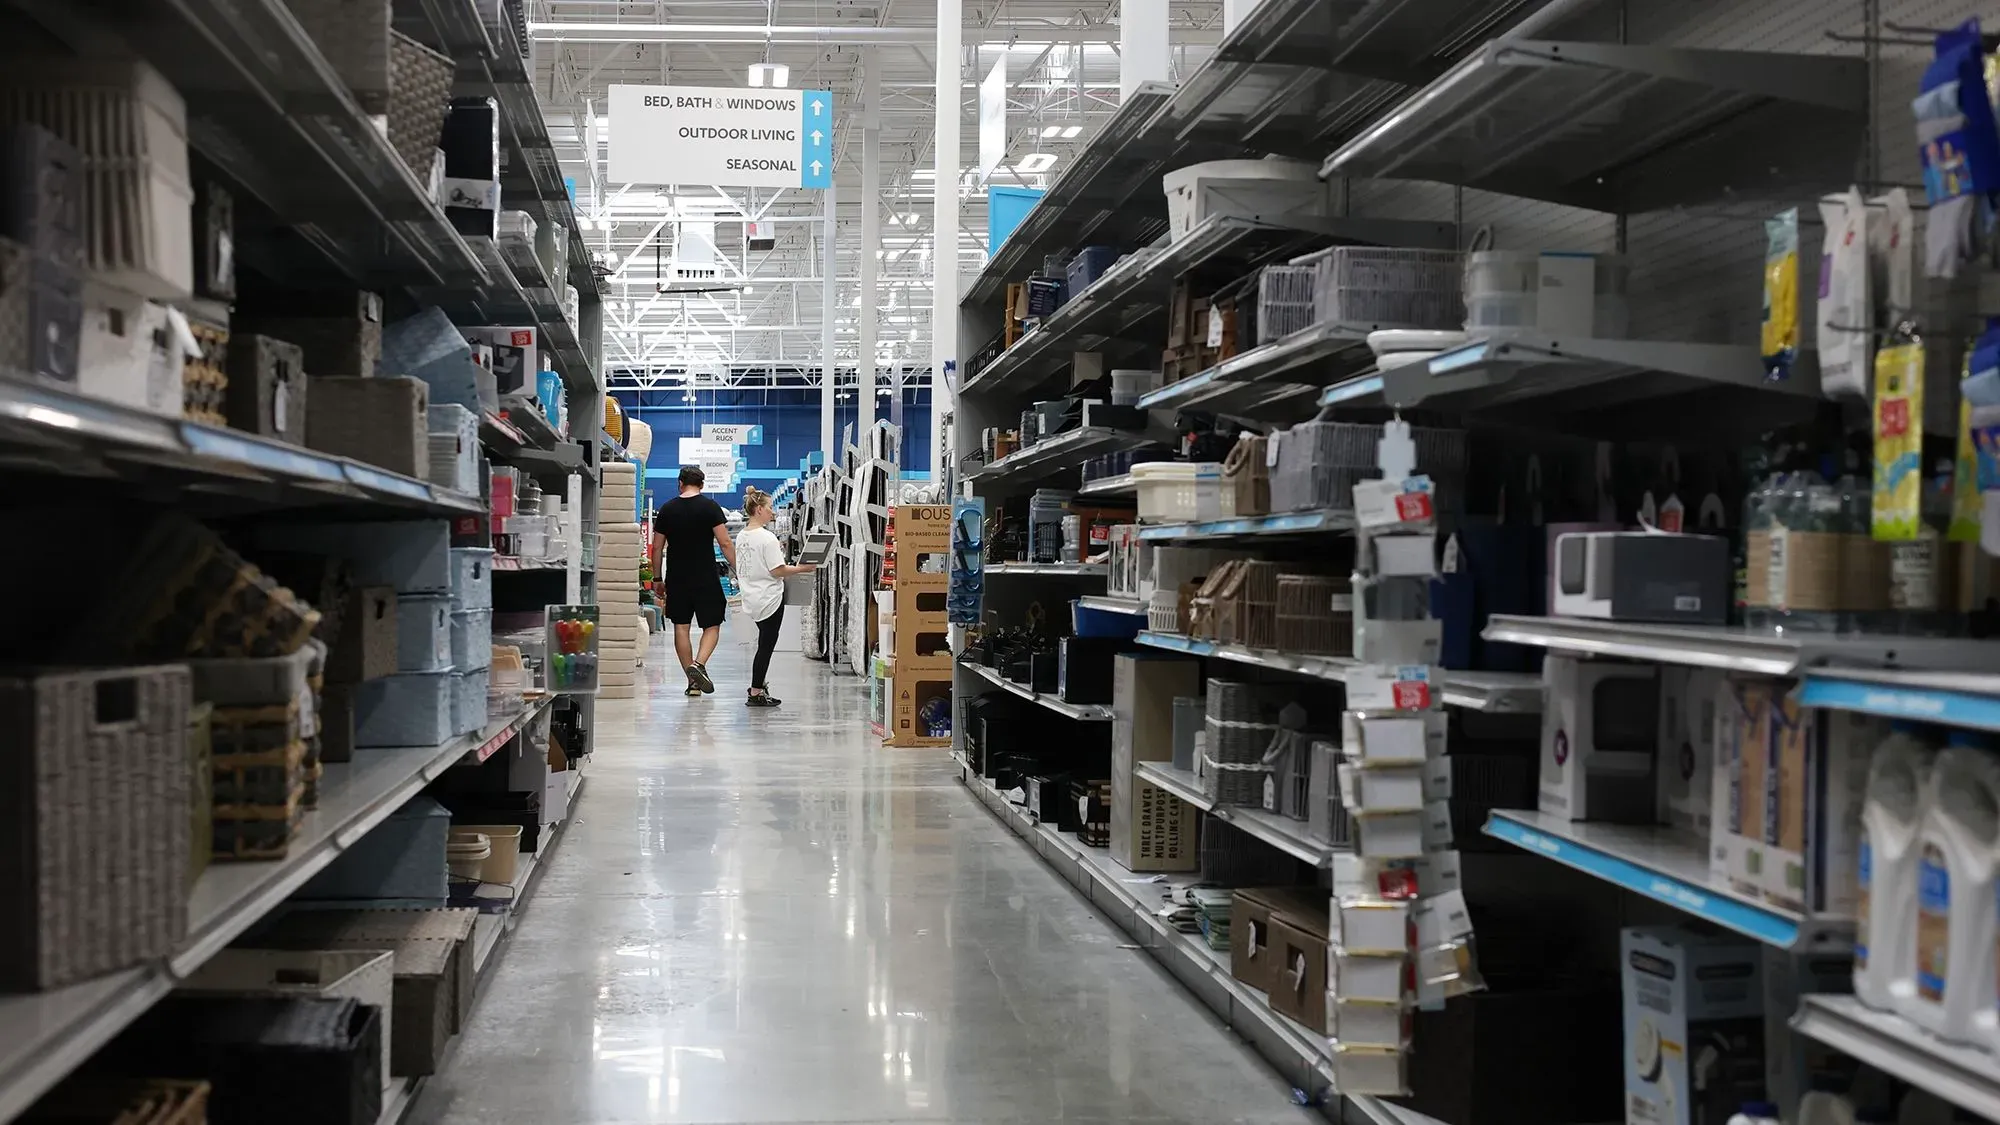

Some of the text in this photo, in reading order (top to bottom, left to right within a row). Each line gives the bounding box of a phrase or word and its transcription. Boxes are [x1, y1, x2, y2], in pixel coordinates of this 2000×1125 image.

[644, 96, 796, 111] BED, BATH & WINDOWS
[679, 127, 795, 141] OUTDOOR LIVING
[726, 158, 797, 171] SEASONAL
[912, 508, 951, 520] OUS
[1141, 788, 1153, 858] THREE DRAWER
[1155, 786, 1166, 859] MULTIPURPOSE
[1169, 820, 1179, 859] ROLLING
